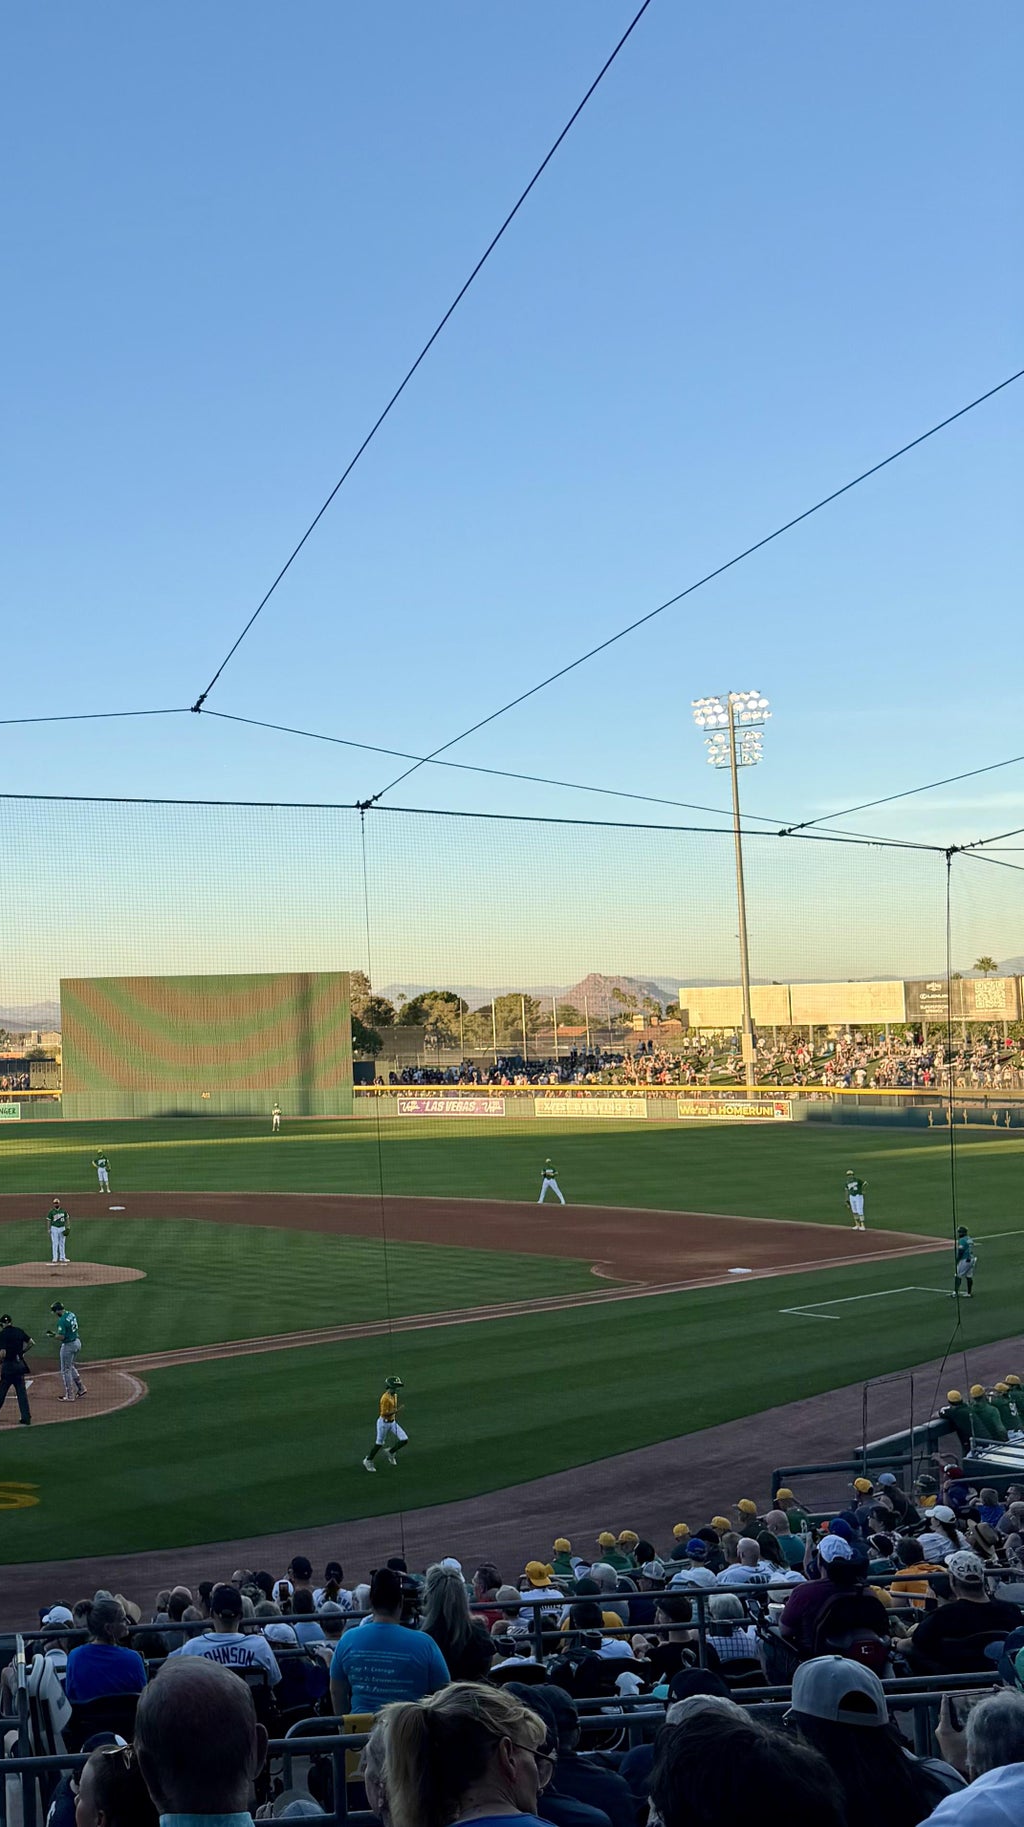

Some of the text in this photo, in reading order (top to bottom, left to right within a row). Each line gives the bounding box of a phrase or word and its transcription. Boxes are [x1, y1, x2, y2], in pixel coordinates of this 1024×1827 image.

[425, 1101, 475, 1112] LAS VEGAS
[680, 1106, 708, 1116] We're
[201, 1647, 255, 1666] OHNSON
